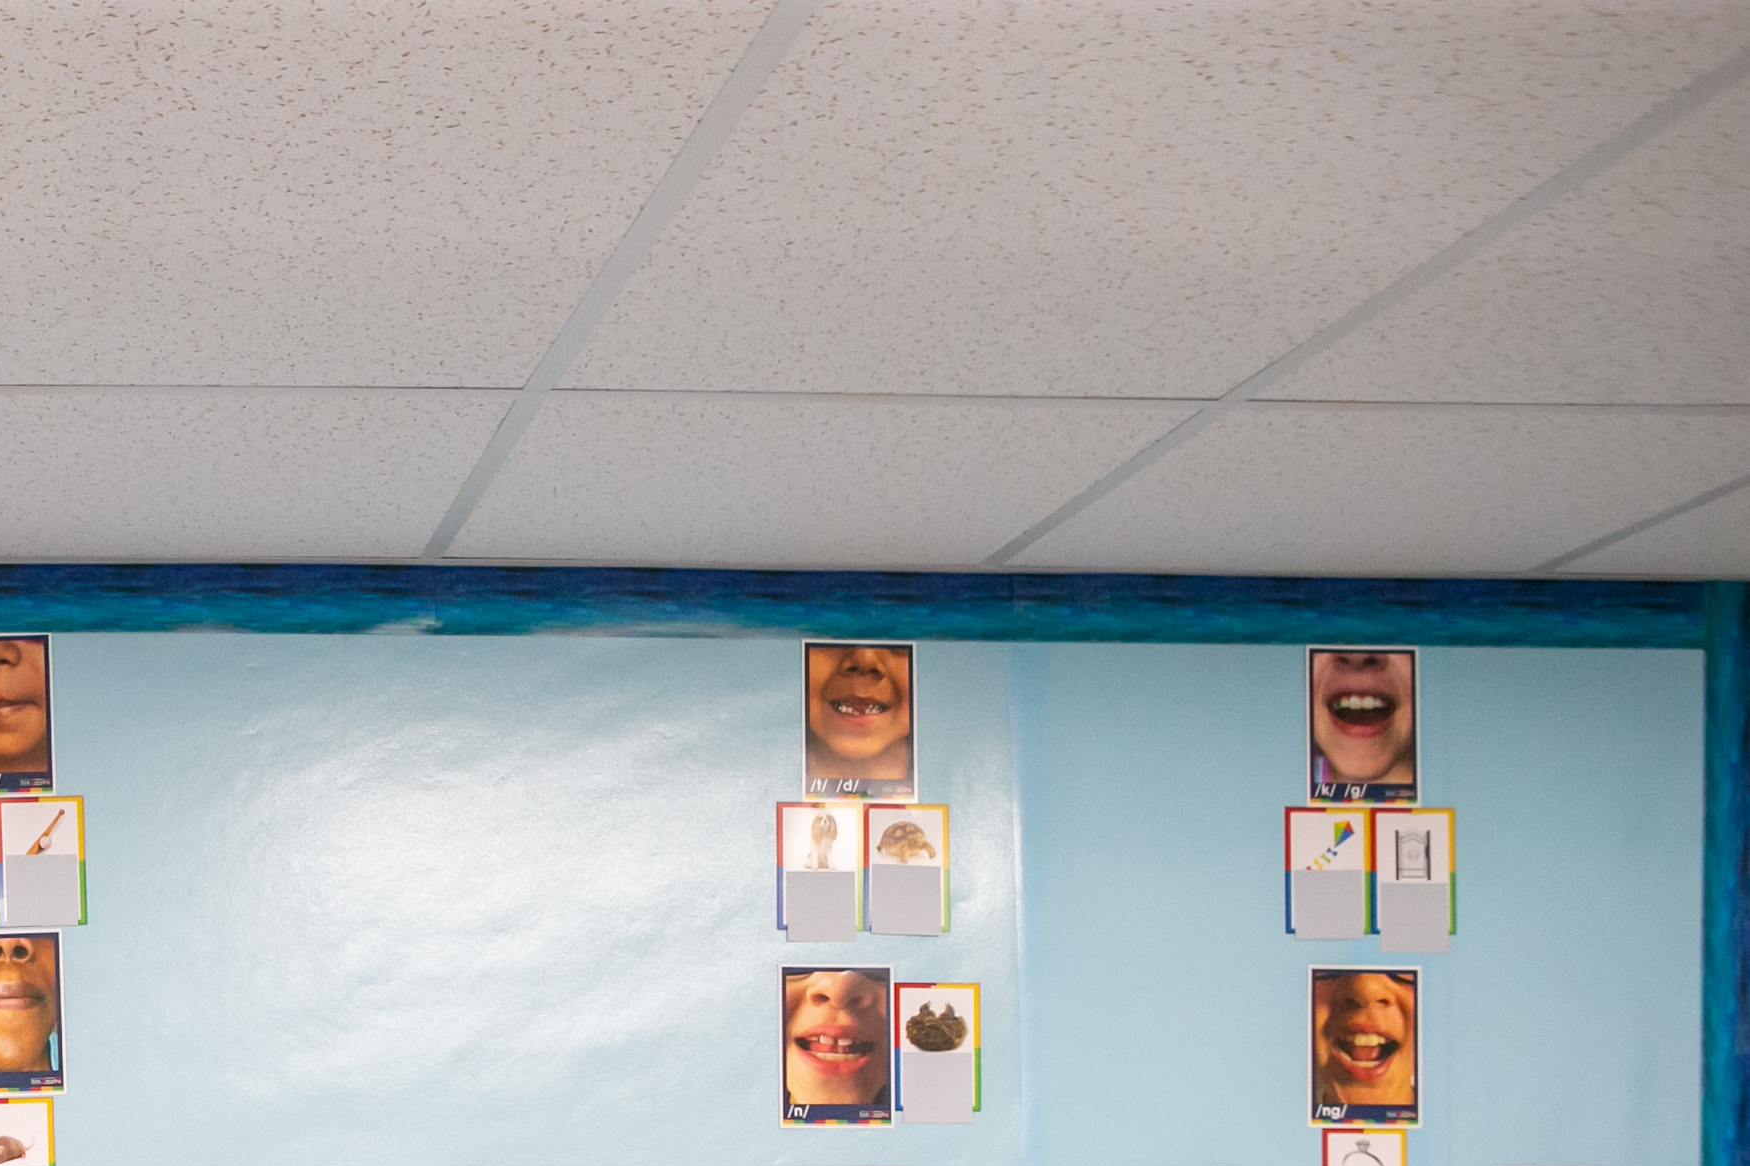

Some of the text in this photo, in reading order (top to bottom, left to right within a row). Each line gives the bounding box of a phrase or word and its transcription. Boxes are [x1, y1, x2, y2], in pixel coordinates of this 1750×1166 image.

[810, 779, 859, 793] /t/ /d/
[1314, 783, 1367, 799] /k/ /g/
[787, 1105, 810, 1118] /n/
[1315, 1104, 1348, 1119] /ng/
